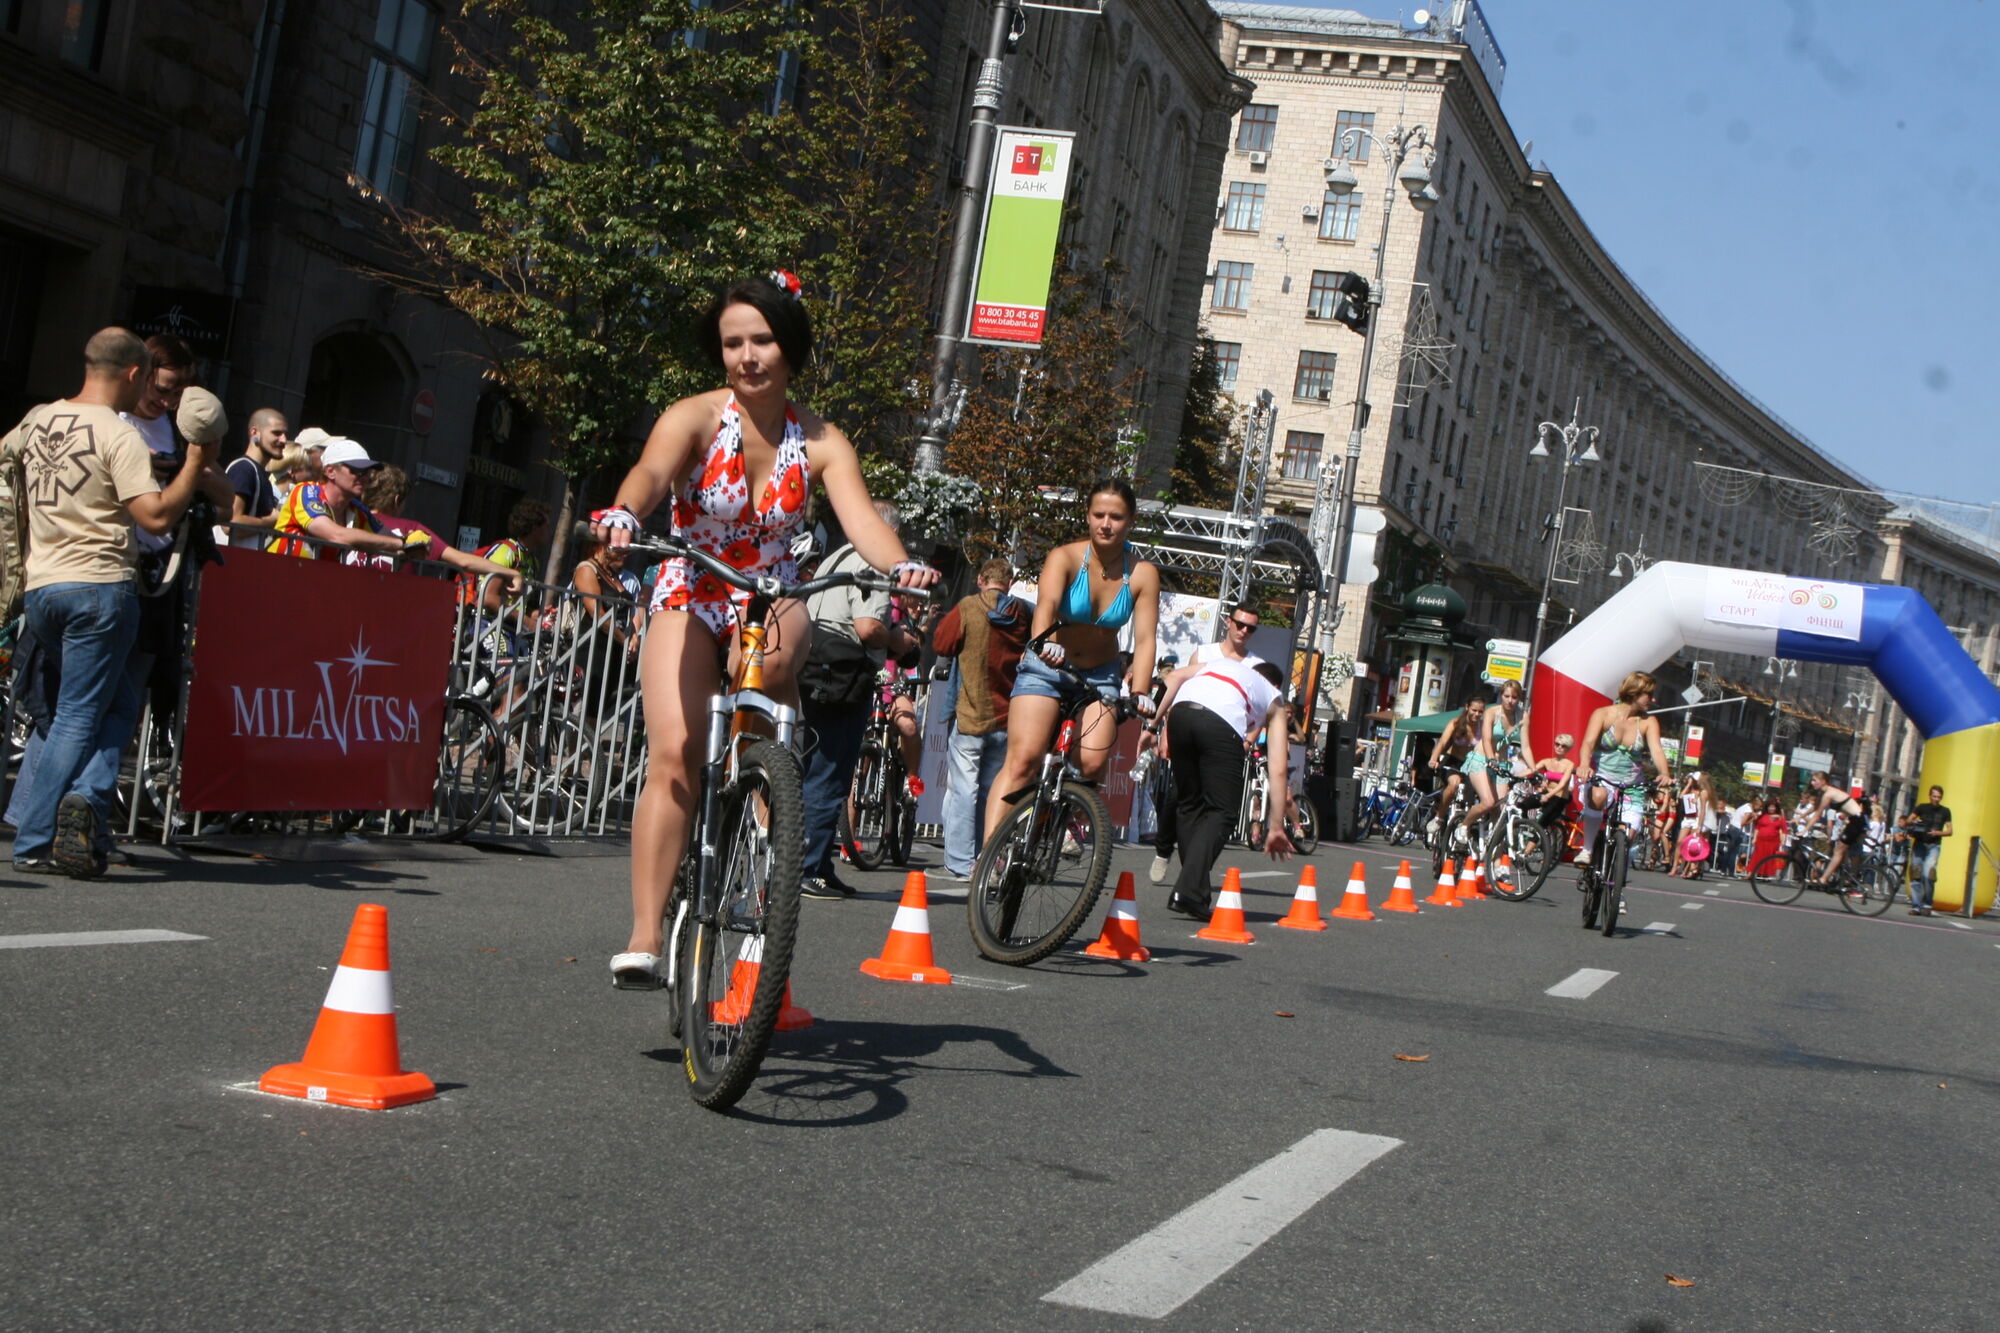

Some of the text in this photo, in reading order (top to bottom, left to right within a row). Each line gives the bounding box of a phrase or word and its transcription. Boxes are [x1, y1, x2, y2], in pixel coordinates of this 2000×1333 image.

[1015, 151, 1053, 166] БТА
[1013, 180, 1048, 193] БАНК
[980, 306, 1040, 321] 0 800 30 45 45
[978, 317, 1039, 328] www.btabank.ua
[1720, 604, 1757, 617] СТАРТ
[231, 661, 421, 756] MILAVITSA
